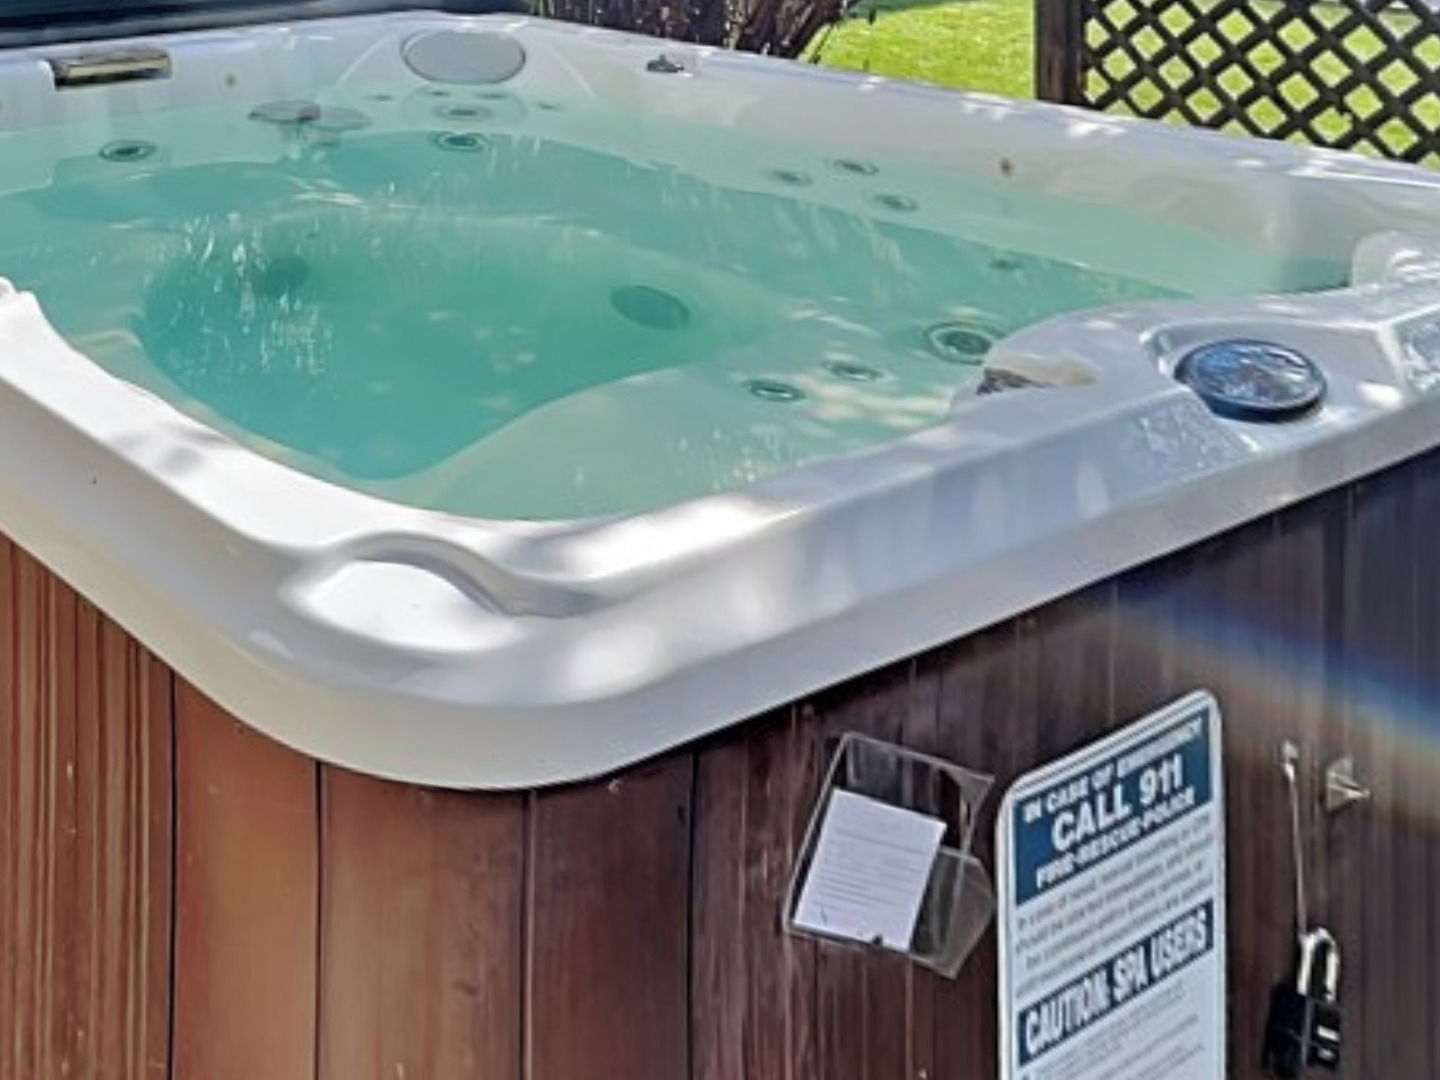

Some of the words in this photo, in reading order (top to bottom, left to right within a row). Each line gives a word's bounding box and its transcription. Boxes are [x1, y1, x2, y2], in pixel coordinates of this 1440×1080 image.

[1051, 783, 1133, 851] CALL
[1139, 753, 1183, 806] 911
[1112, 943, 1150, 1003] SPA
[1151, 906, 1208, 978] USERS
